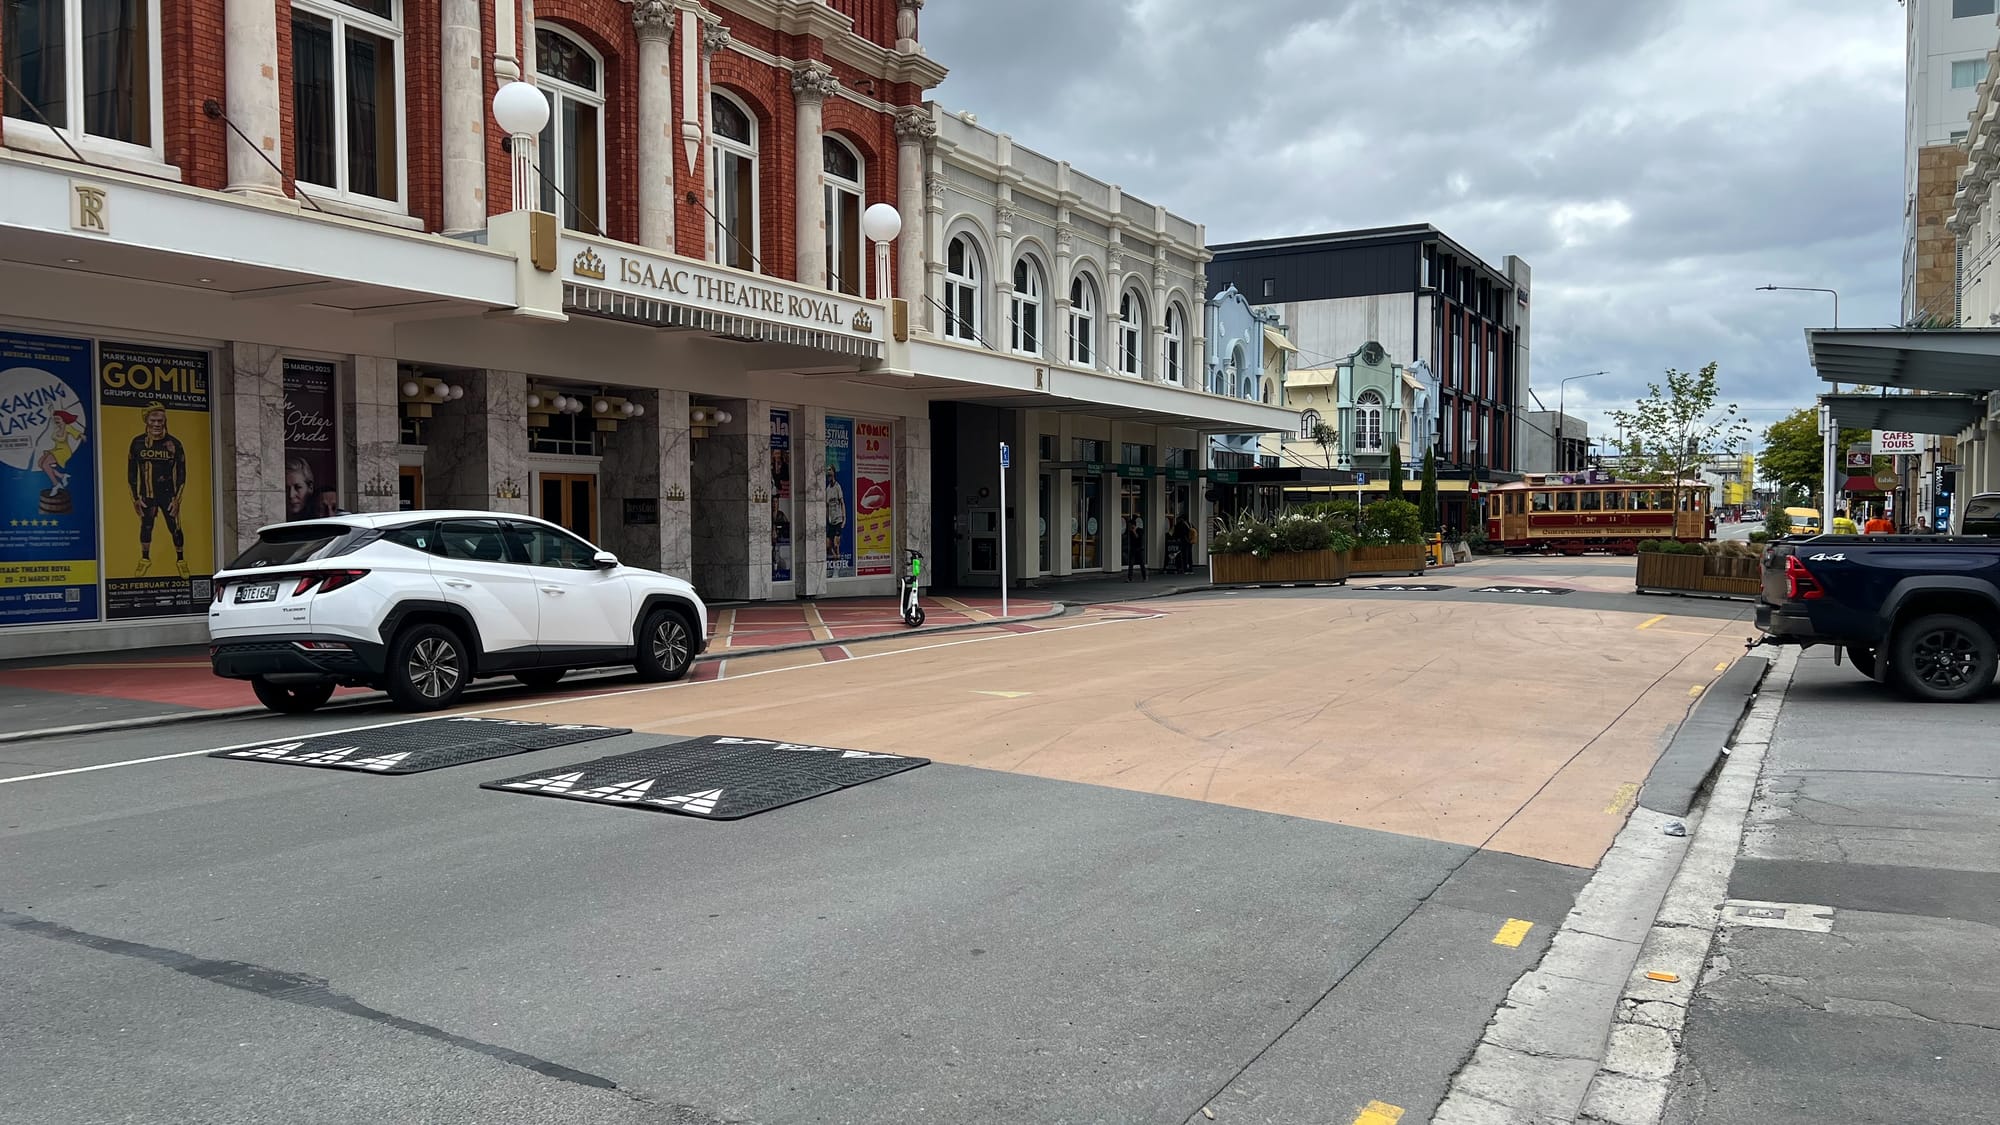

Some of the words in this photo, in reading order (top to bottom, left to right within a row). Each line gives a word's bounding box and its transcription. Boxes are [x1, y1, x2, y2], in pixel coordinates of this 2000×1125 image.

[620, 256, 689, 295] ISAAC
[693, 274, 785, 315] THEATRE
[788, 295, 844, 326] ROYAL
[102, 352, 125, 361] MARK
[126, 355, 162, 364] HADLOW
[172, 360, 196, 368] MAMIL
[290, 363, 314, 371] MARCH
[102, 361, 206, 395] GOMIL
[0, 383, 66, 417] EAKING
[103, 389, 137, 398] GRUMPY
[138, 391, 155, 399] OLD
[155, 393, 173, 401] MAN
[183, 395, 207, 403] LYCRA
[287, 410, 333, 427] Other
[856, 423, 889, 438] ATOMIC!
[1883, 432, 1914, 440] CAFES
[866, 439, 880, 452] 2.0
[1882, 440, 1914, 448] TOURS
[140, 449, 171, 459] GOMIL
[1809, 553, 1846, 562] 4x4
[21, 565, 49, 573] THEATRE
[130, 581, 170, 590] FEBRUARY
